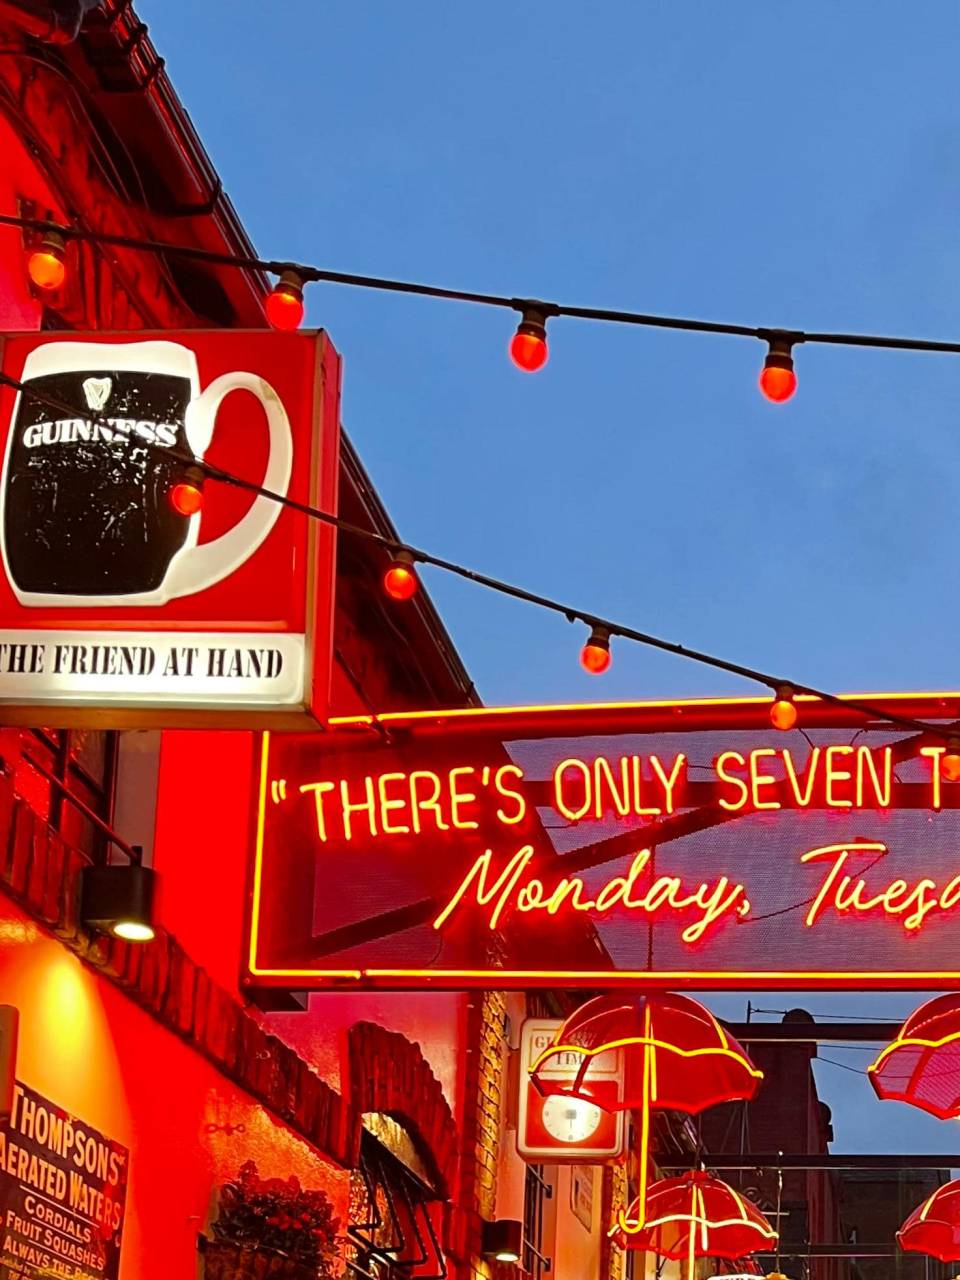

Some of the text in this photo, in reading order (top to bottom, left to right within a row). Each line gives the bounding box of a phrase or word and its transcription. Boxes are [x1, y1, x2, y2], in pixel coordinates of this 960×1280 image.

[23, 418, 178, 448] GUINNESS
[0, 644, 284, 680] THE FRIEND AT HAND
[555, 753, 686, 822] ONLY
[716, 745, 892, 811] SEVEN
[433, 845, 751, 941] Monday,
[557, 1053, 594, 1066] TIM
[24, 1195, 91, 1243] CORDIALS
[70, 1170, 121, 1230] WATERS
[3, 1235, 50, 1268] ALWAYS
[52, 1258, 72, 1276] THE
[6, 1209, 42, 1242] FRUIT
[43, 1229, 105, 1271] SQUASHES
